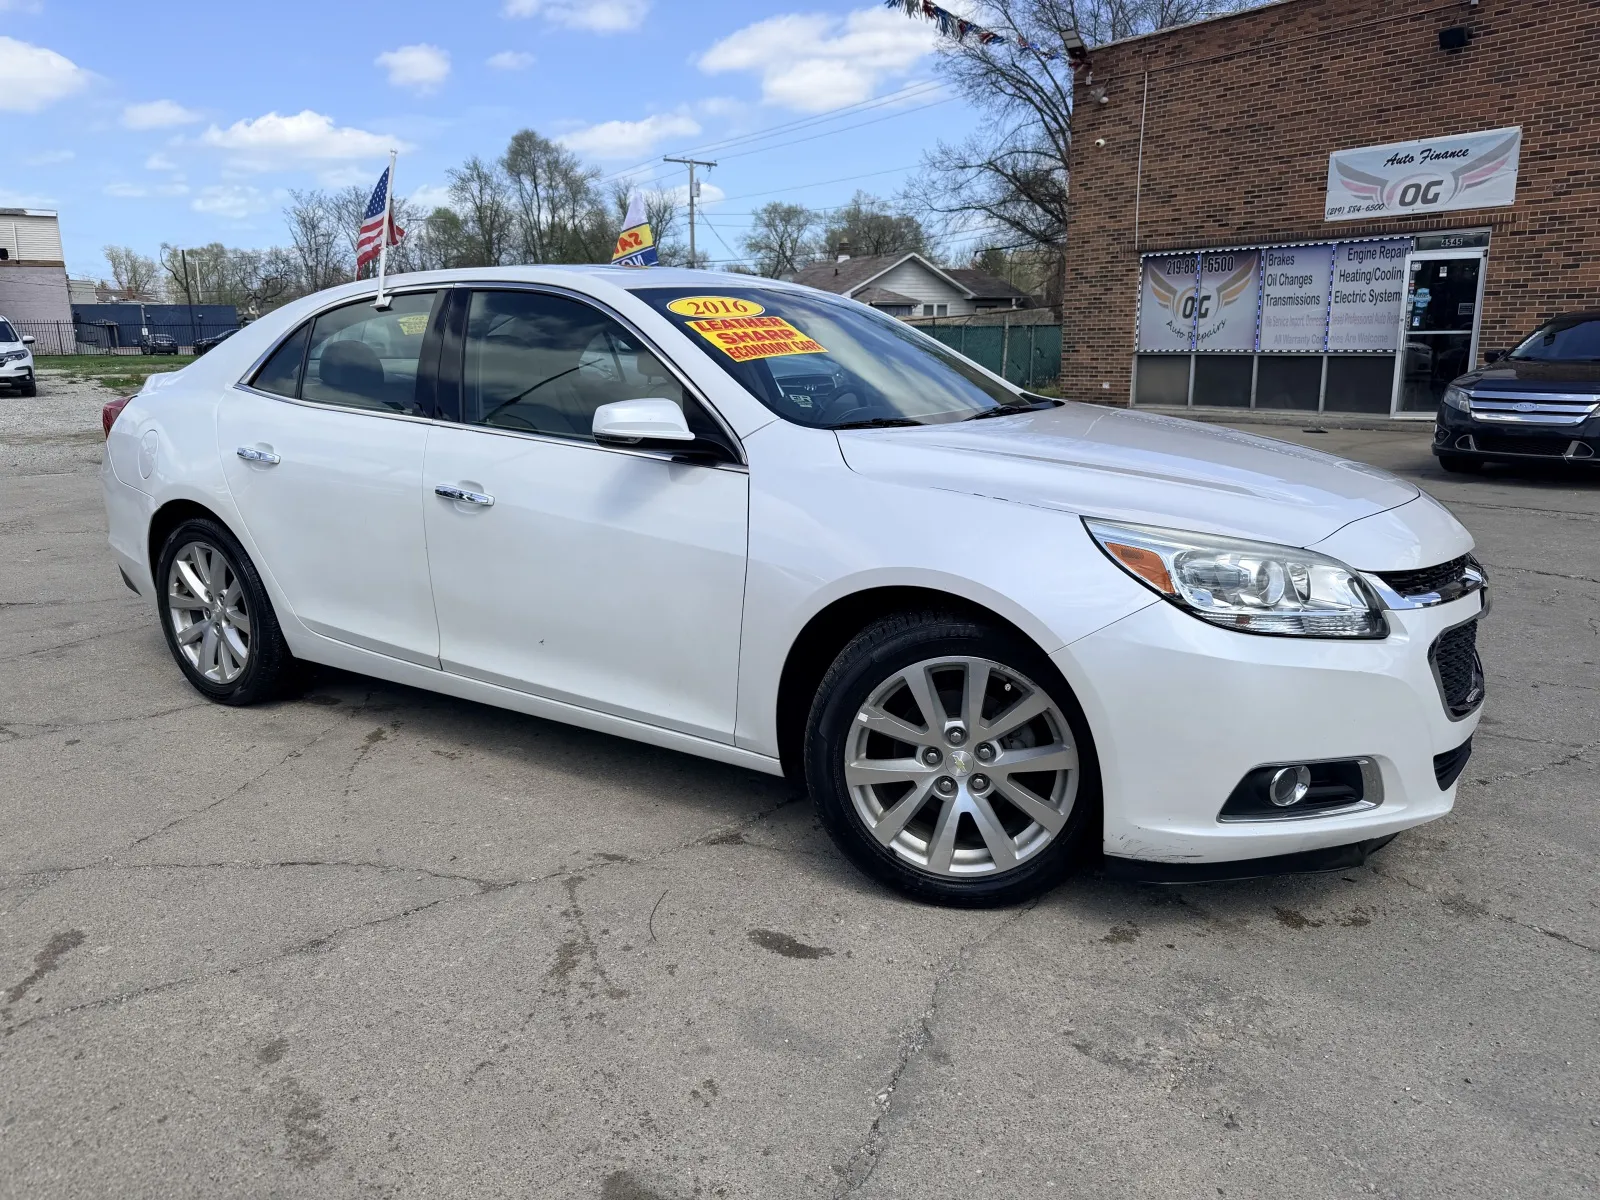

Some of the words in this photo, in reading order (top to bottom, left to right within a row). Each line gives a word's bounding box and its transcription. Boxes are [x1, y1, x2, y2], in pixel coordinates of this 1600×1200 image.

[1383, 152, 1415, 167] Auto
[1419, 147, 1470, 165] Finance
[1398, 179, 1444, 207] OG
[1326, 206, 1345, 216] (219)
[1347, 202, 1385, 214] 884-6500
[1268, 253, 1295, 267] Brakes
[1347, 247, 1376, 264] Engine
[1379, 244, 1408, 263] Repair
[1266, 274, 1277, 287] Oil
[1278, 272, 1313, 288] Changes
[1265, 293, 1321, 307] Transmissions
[1334, 290, 1367, 304] Electric
[687, 300, 748, 315] 2016
[1182, 294, 1211, 319] OG
[693, 317, 788, 332] LEATHER
[1166, 320, 1186, 339] Auto
[716, 328, 798, 345] SHARP
[725, 341, 794, 360] ECONOMY
[792, 339, 821, 351] CAR
